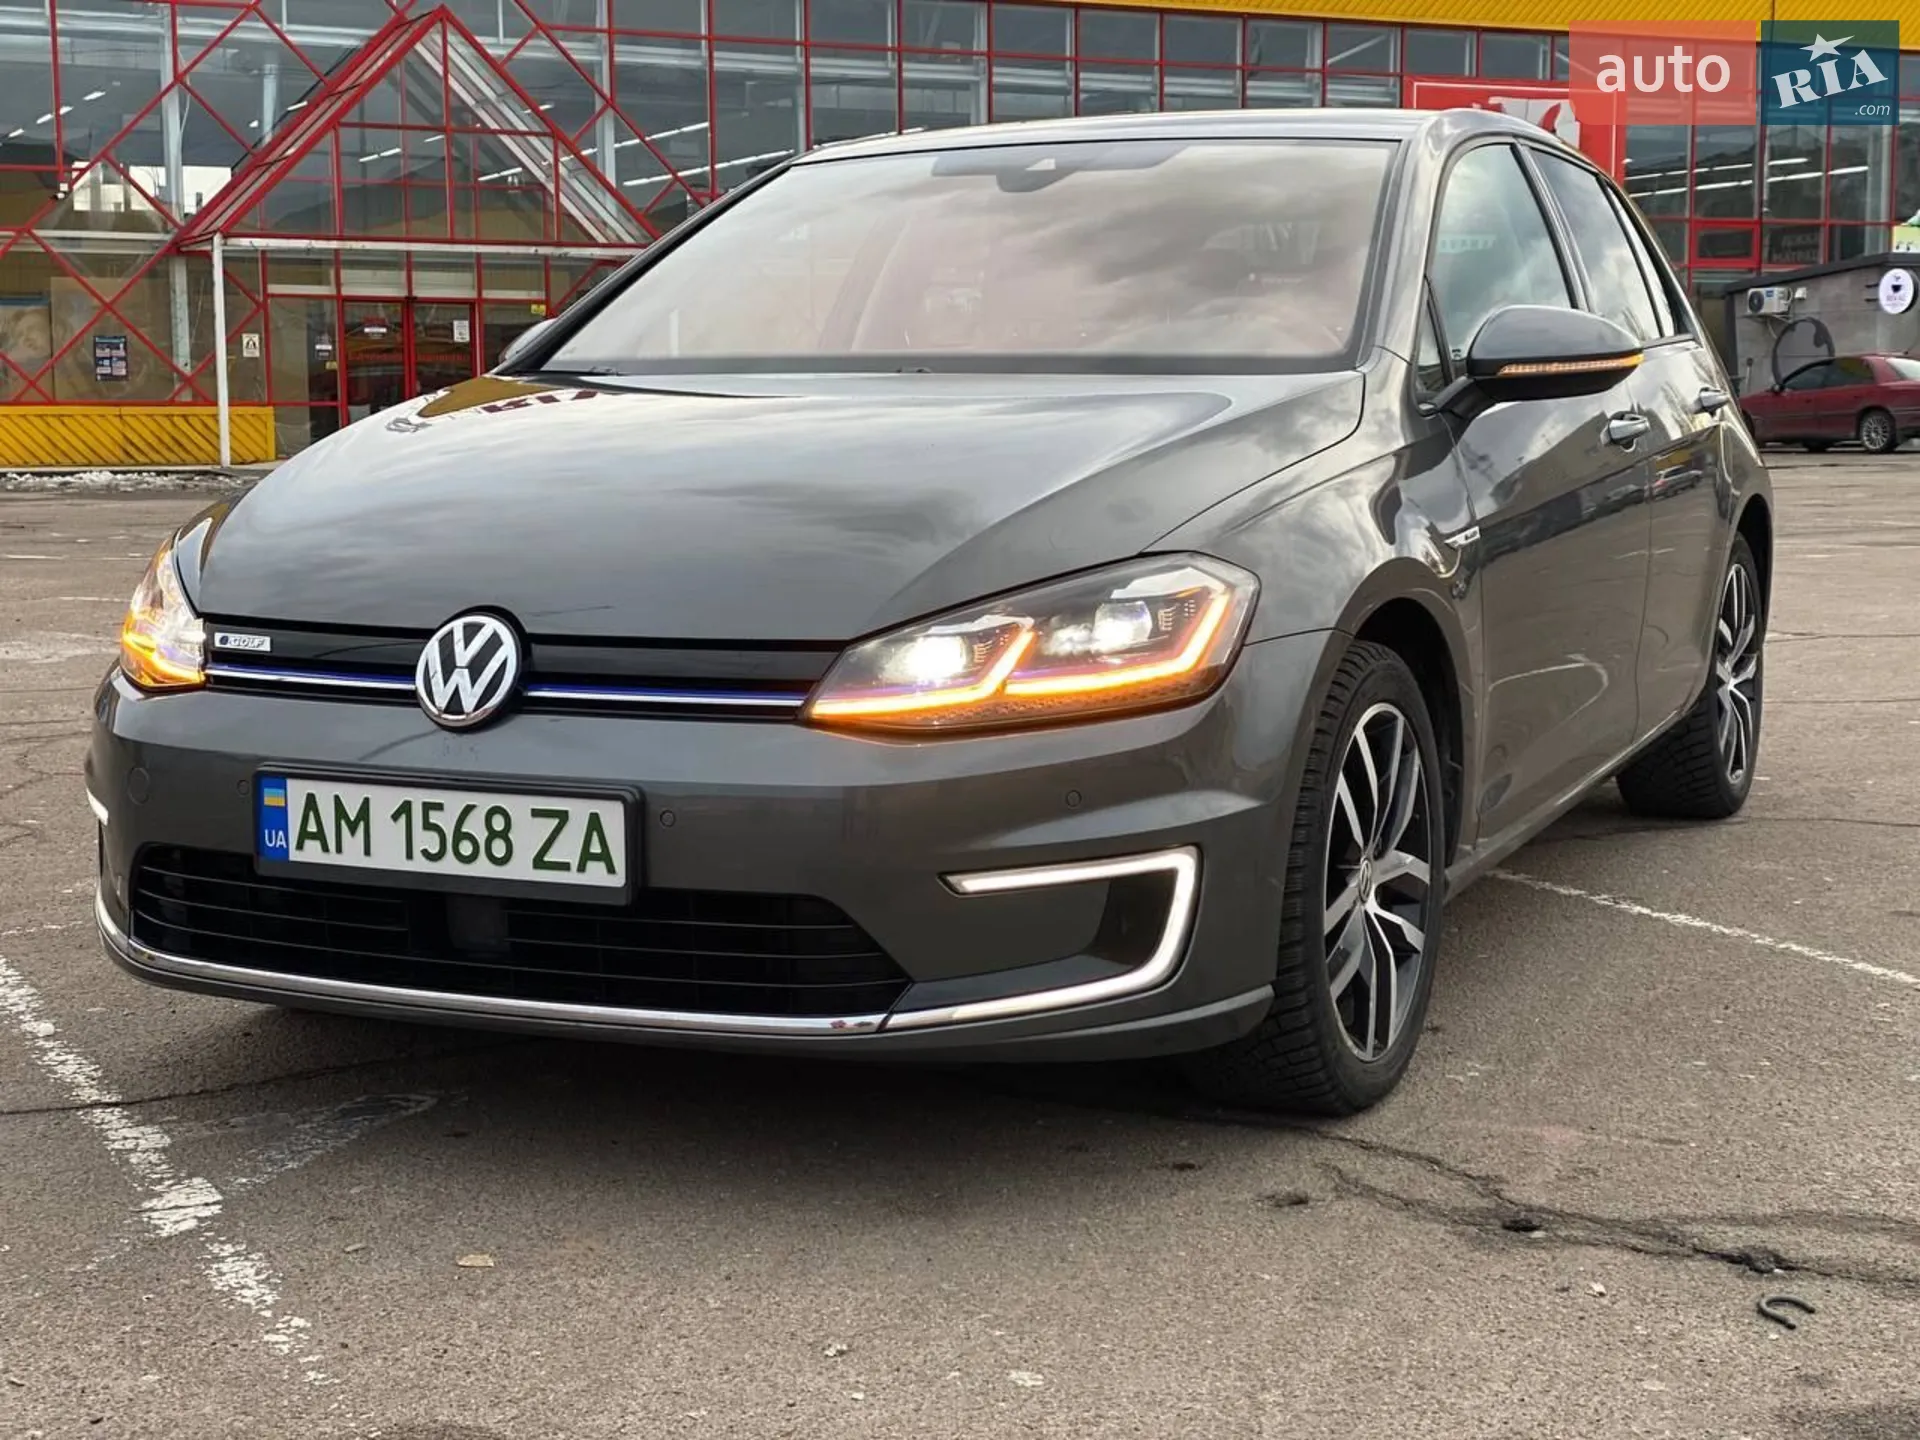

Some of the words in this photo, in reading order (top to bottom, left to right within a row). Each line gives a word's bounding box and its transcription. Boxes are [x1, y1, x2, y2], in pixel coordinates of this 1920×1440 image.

[264, 828, 288, 849] UA
[295, 791, 372, 857] AM
[390, 798, 514, 867] 1568
[530, 807, 617, 875] ZA
